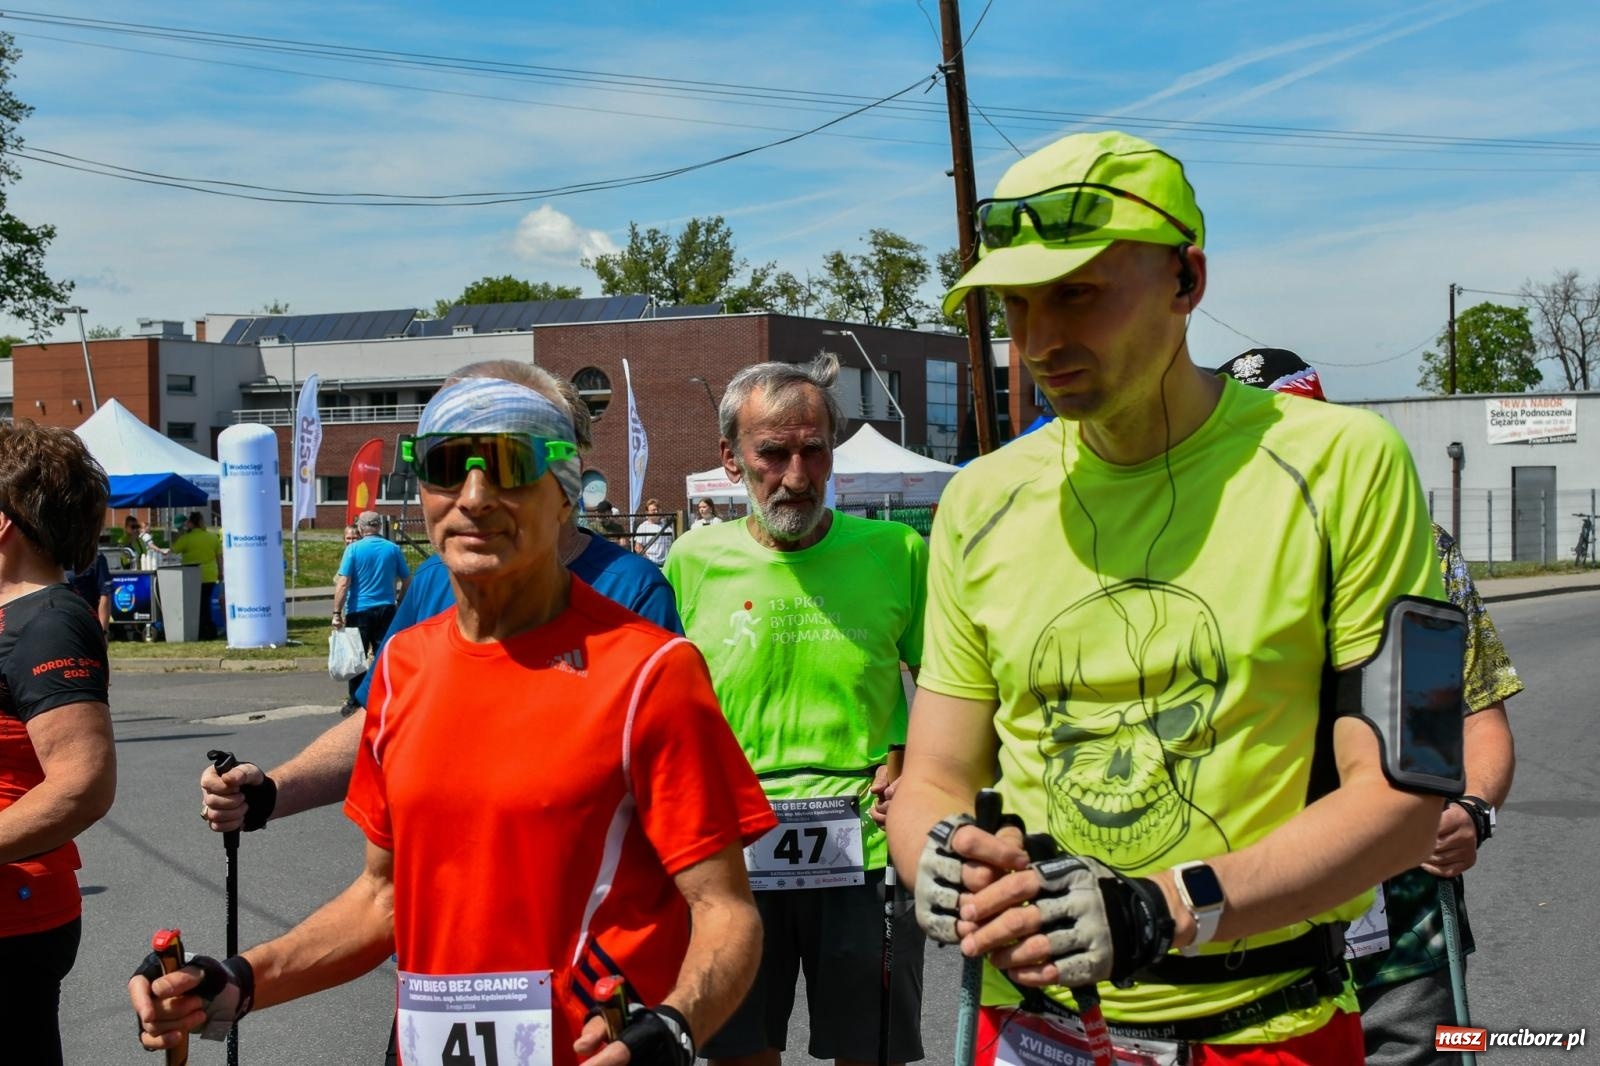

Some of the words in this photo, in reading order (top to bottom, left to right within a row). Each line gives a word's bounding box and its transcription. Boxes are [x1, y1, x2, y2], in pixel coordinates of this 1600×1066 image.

[1490, 409, 1518, 419] Sekcja
[1520, 408, 1572, 417] Podnoszenia
[769, 599, 790, 611] 13.
[794, 596, 824, 610] PKO
[770, 612, 841, 629] BYTOMSKI
[771, 629, 868, 645] PÓŁMARATON
[32, 658, 75, 676] NORDIC
[790, 802, 807, 811] BEZ
[808, 800, 845, 809] GRANIC
[773, 827, 828, 865] 47
[409, 978, 422, 991] XVI
[423, 979, 447, 992] BIEG
[448, 979, 472, 992] BEZ
[473, 977, 529, 992] GRANIC
[442, 1021, 499, 1066] 41
[1020, 1033, 1042, 1053] XVI
[1044, 1044, 1073, 1064] BIEG
